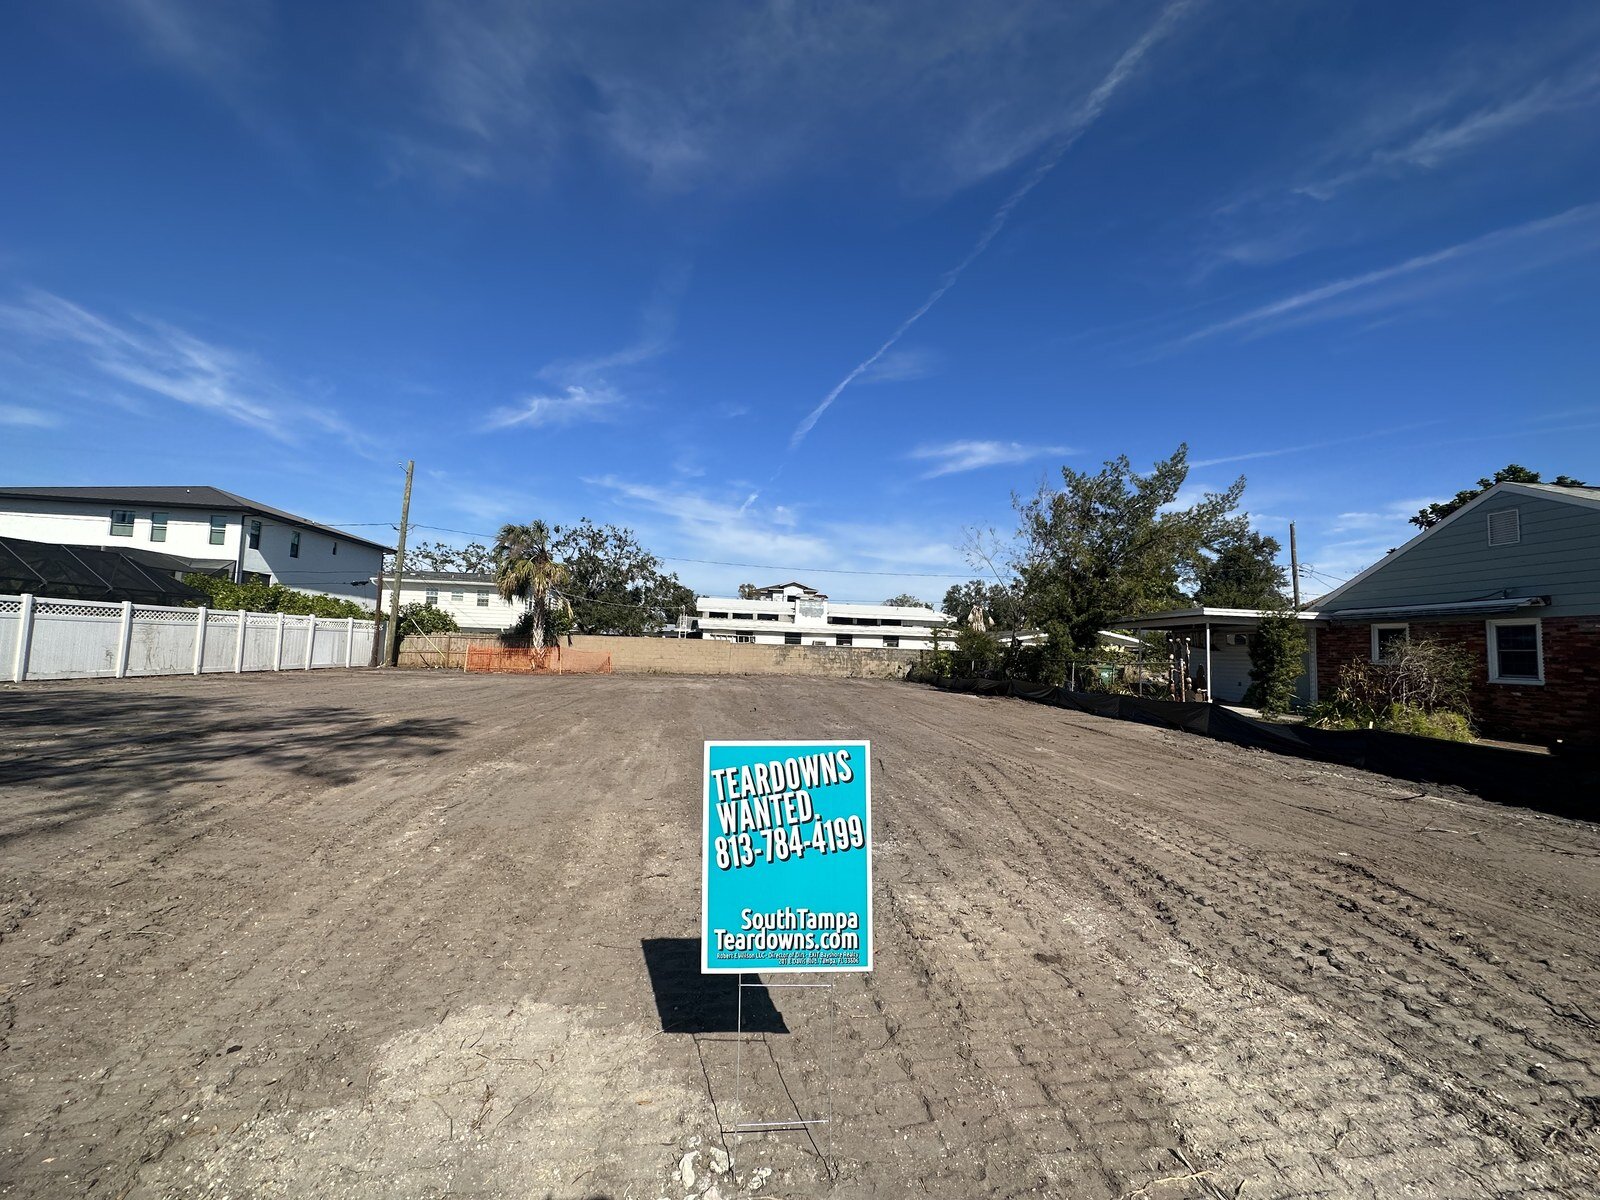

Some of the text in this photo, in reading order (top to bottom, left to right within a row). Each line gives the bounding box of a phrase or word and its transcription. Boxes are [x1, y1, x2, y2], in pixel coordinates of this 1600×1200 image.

[711, 749, 853, 802] TEARDOWNS
[716, 789, 822, 835] WANTED.
[714, 814, 865, 870] 813-784-4199
[714, 928, 859, 951] Teardowns.com
